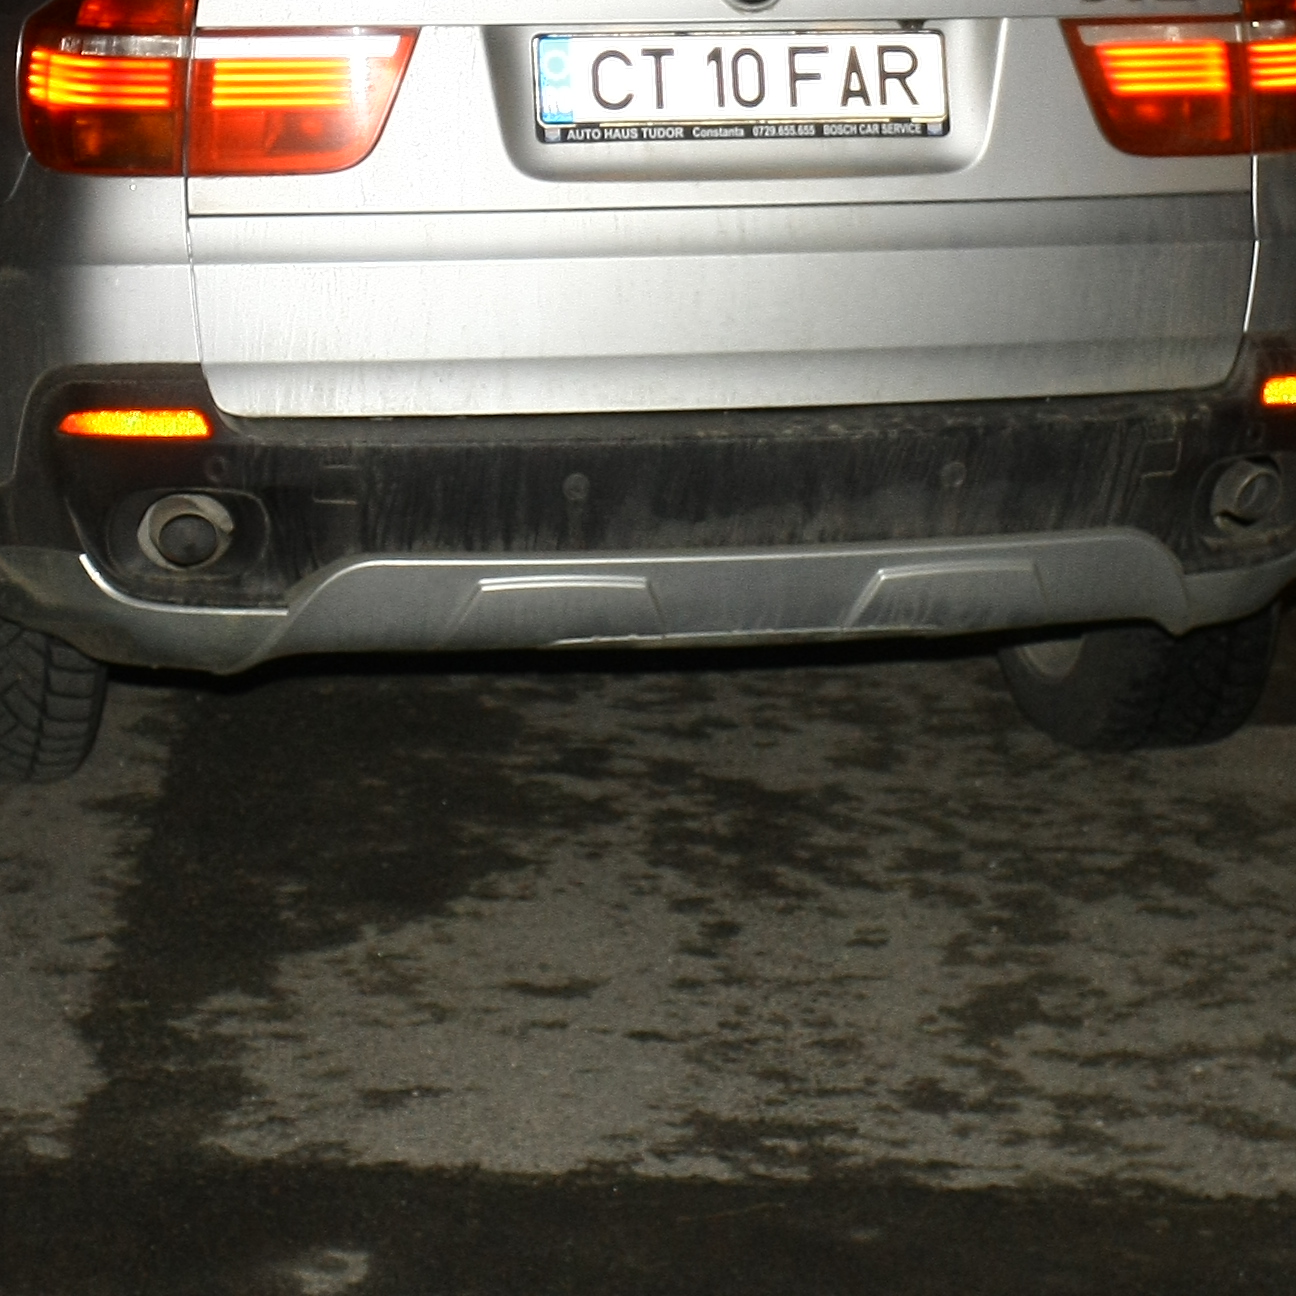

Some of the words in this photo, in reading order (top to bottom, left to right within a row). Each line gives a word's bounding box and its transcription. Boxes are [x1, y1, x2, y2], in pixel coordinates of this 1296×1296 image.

[591, 47, 675, 110] CT
[706, 46, 765, 108] 10
[788, 45, 919, 107] FAR
[566, 128, 601, 141] AUTO
[604, 127, 638, 140] HAUS
[641, 126, 684, 139] TUDOR
[692, 126, 745, 138] Constanta
[823, 123, 857, 136] BOSCH
[859, 122, 880, 135] CAR
[881, 121, 922, 134] SERVICE
